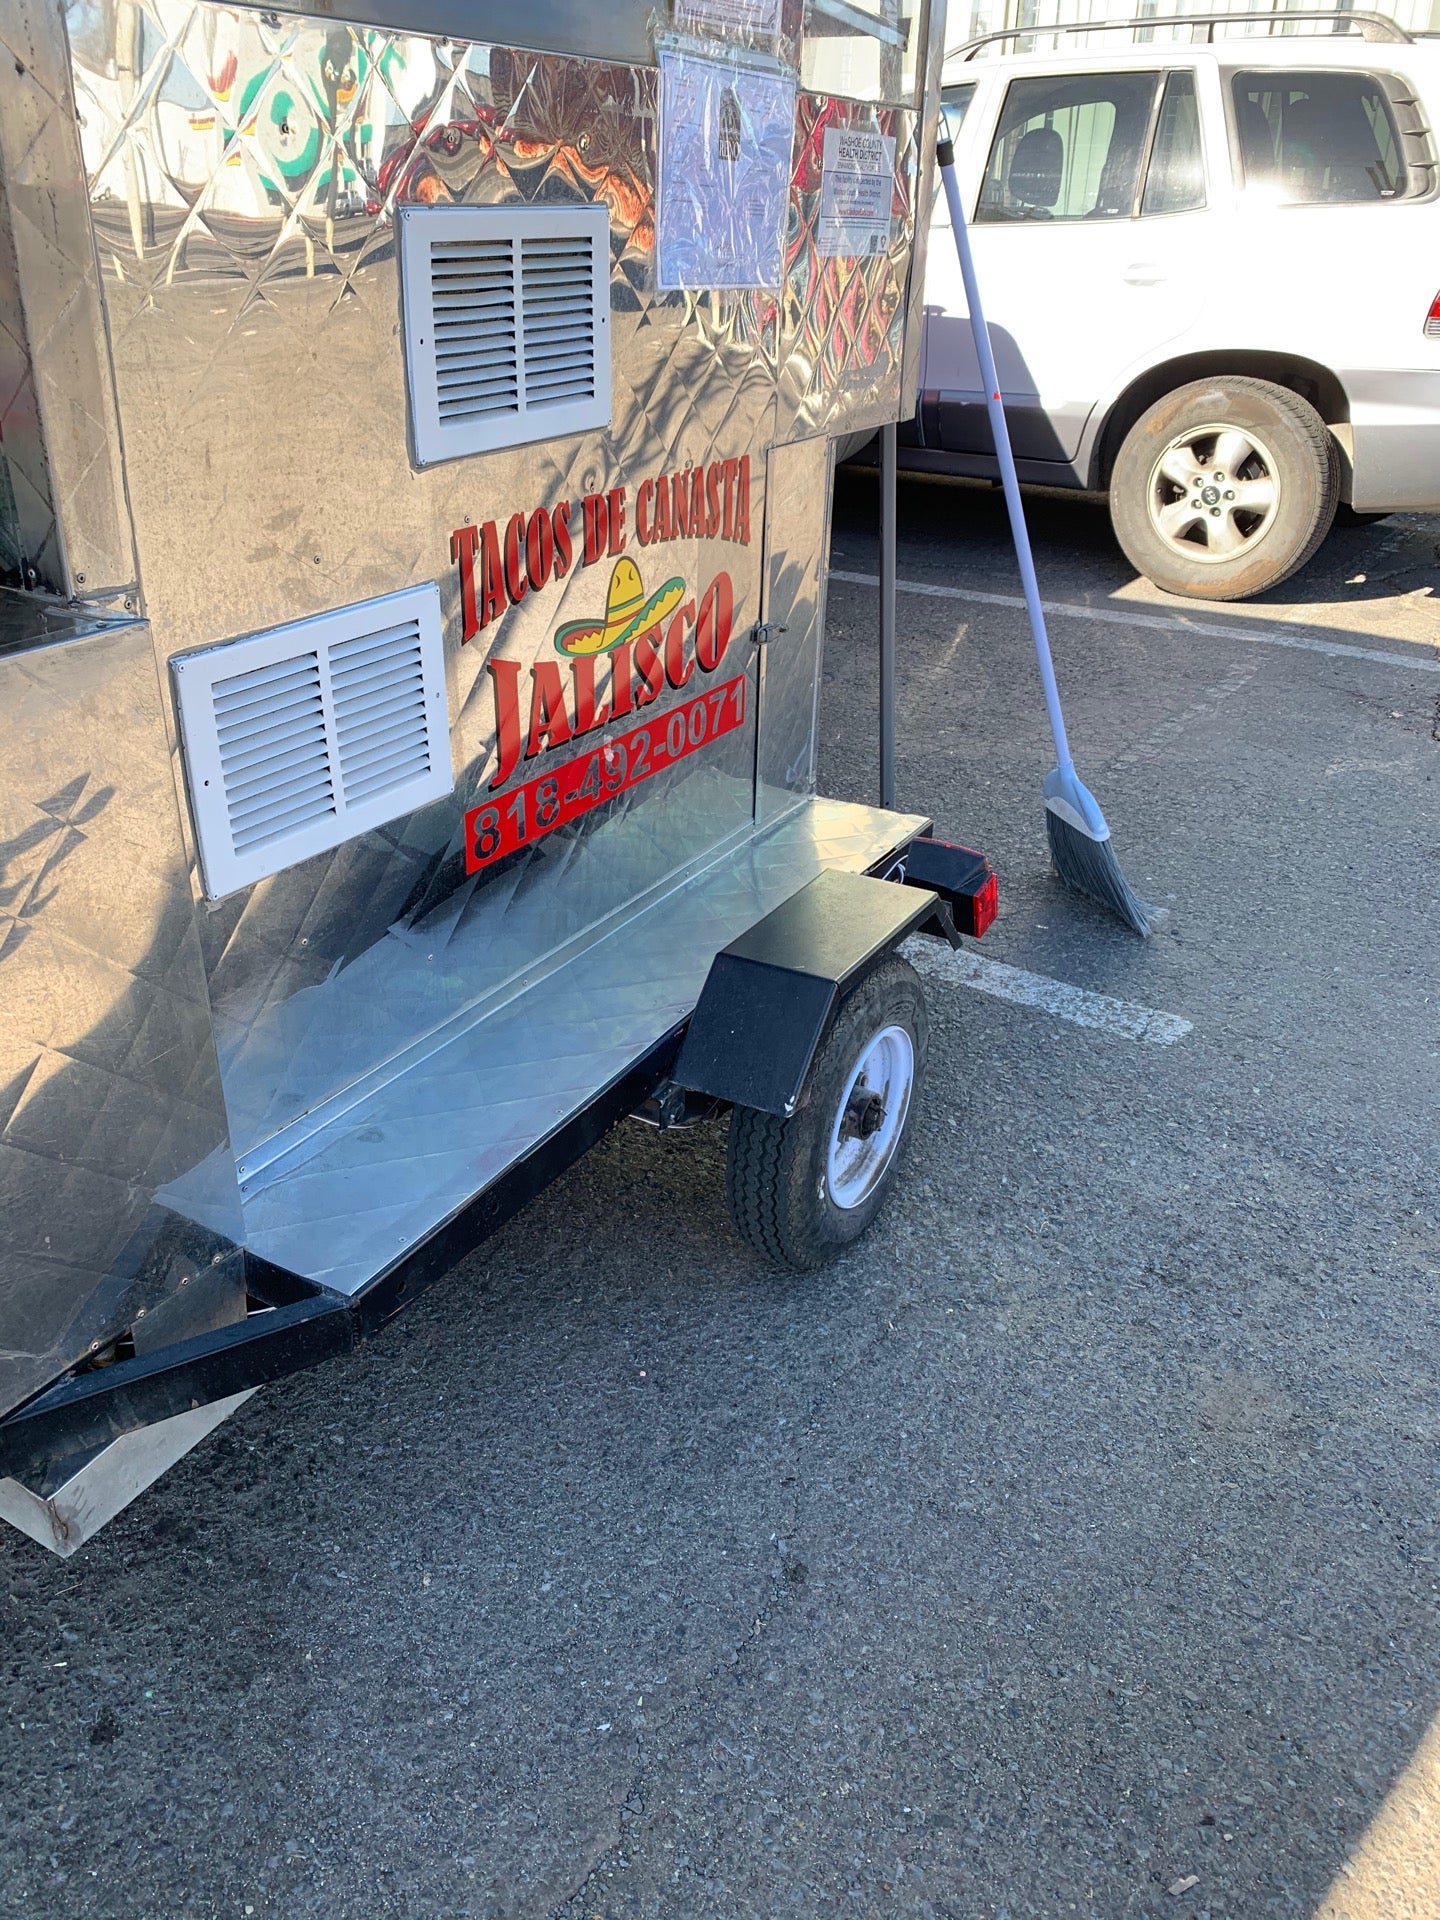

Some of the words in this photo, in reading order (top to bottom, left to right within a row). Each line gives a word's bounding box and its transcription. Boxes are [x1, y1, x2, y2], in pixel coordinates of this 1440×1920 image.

[839, 148, 859, 159] HEALTH
[860, 150, 882, 162] DISTRICT
[840, 136, 862, 148] WASHOE
[862, 138, 883, 151] COUNTY
[450, 500, 573, 646] TACOS
[581, 487, 627, 568] DE
[635, 454, 751, 547] CANASTA
[473, 674, 744, 861] 818-492-0071
[487, 570, 734, 793] JALISCO
